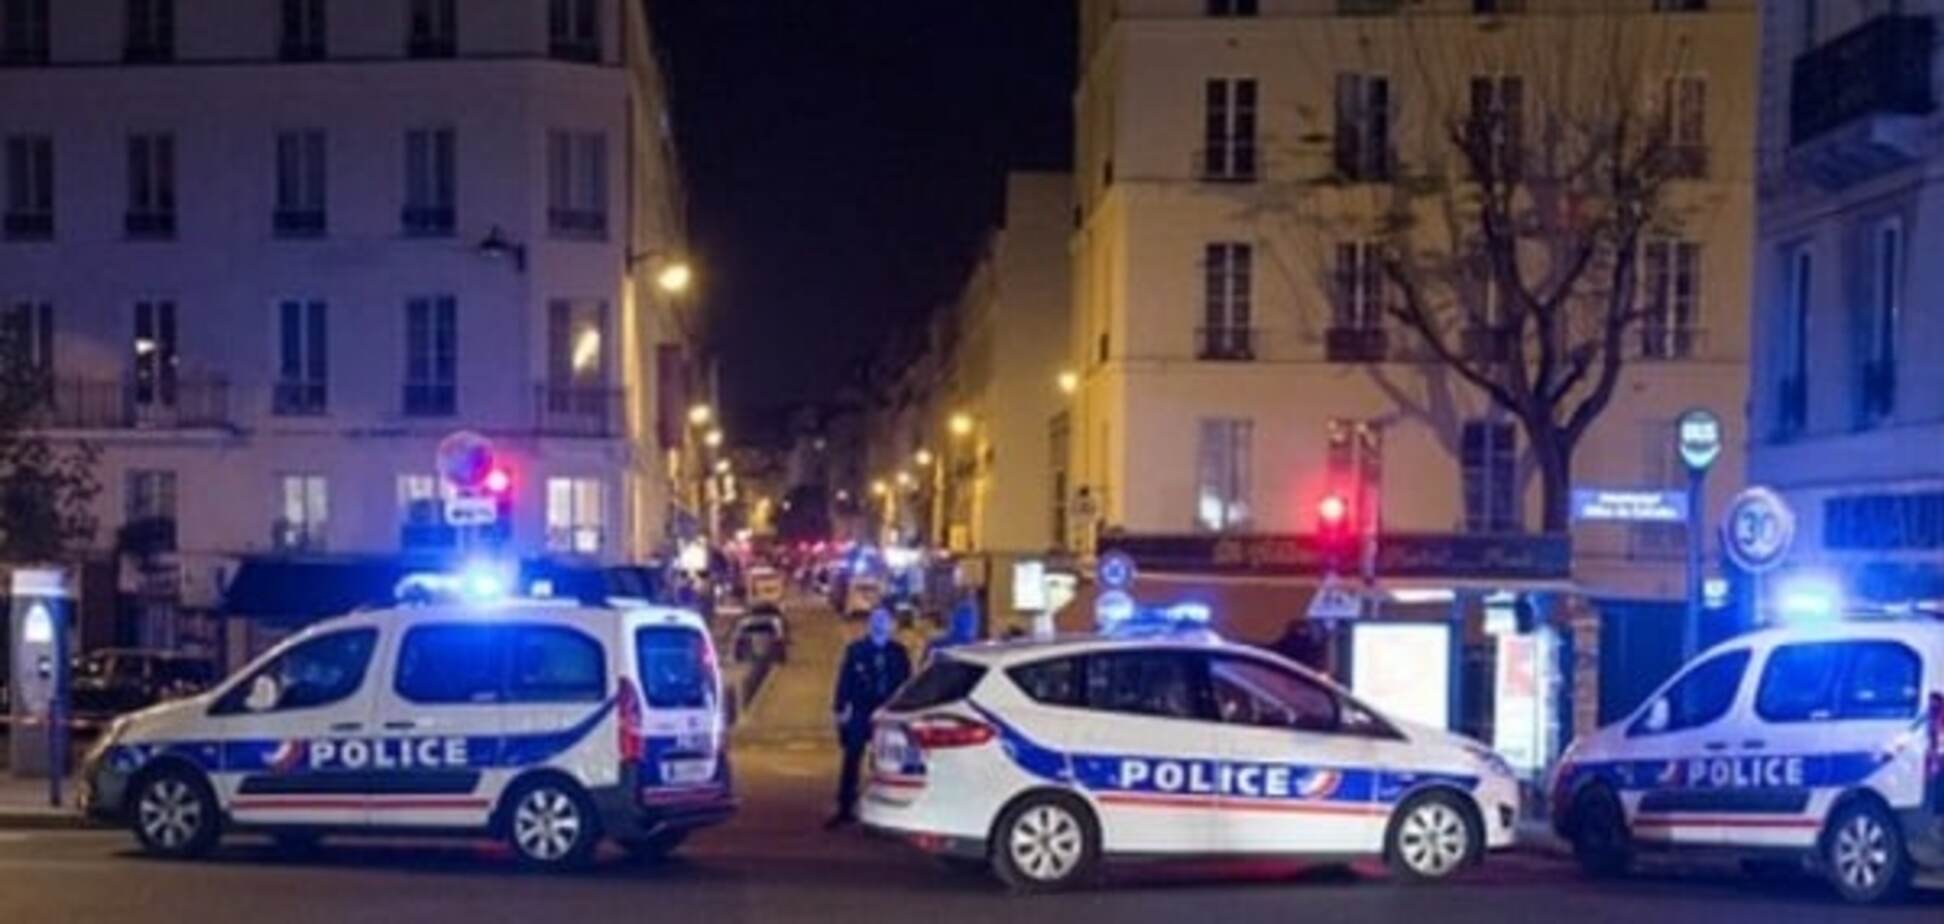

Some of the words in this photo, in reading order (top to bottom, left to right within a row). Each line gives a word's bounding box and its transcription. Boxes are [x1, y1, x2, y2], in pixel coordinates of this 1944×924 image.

[1741, 510, 1779, 547] 30
[310, 738, 468, 769] POLICE
[1120, 759, 1291, 796] POLICE
[1688, 757, 1803, 787] POLICE
